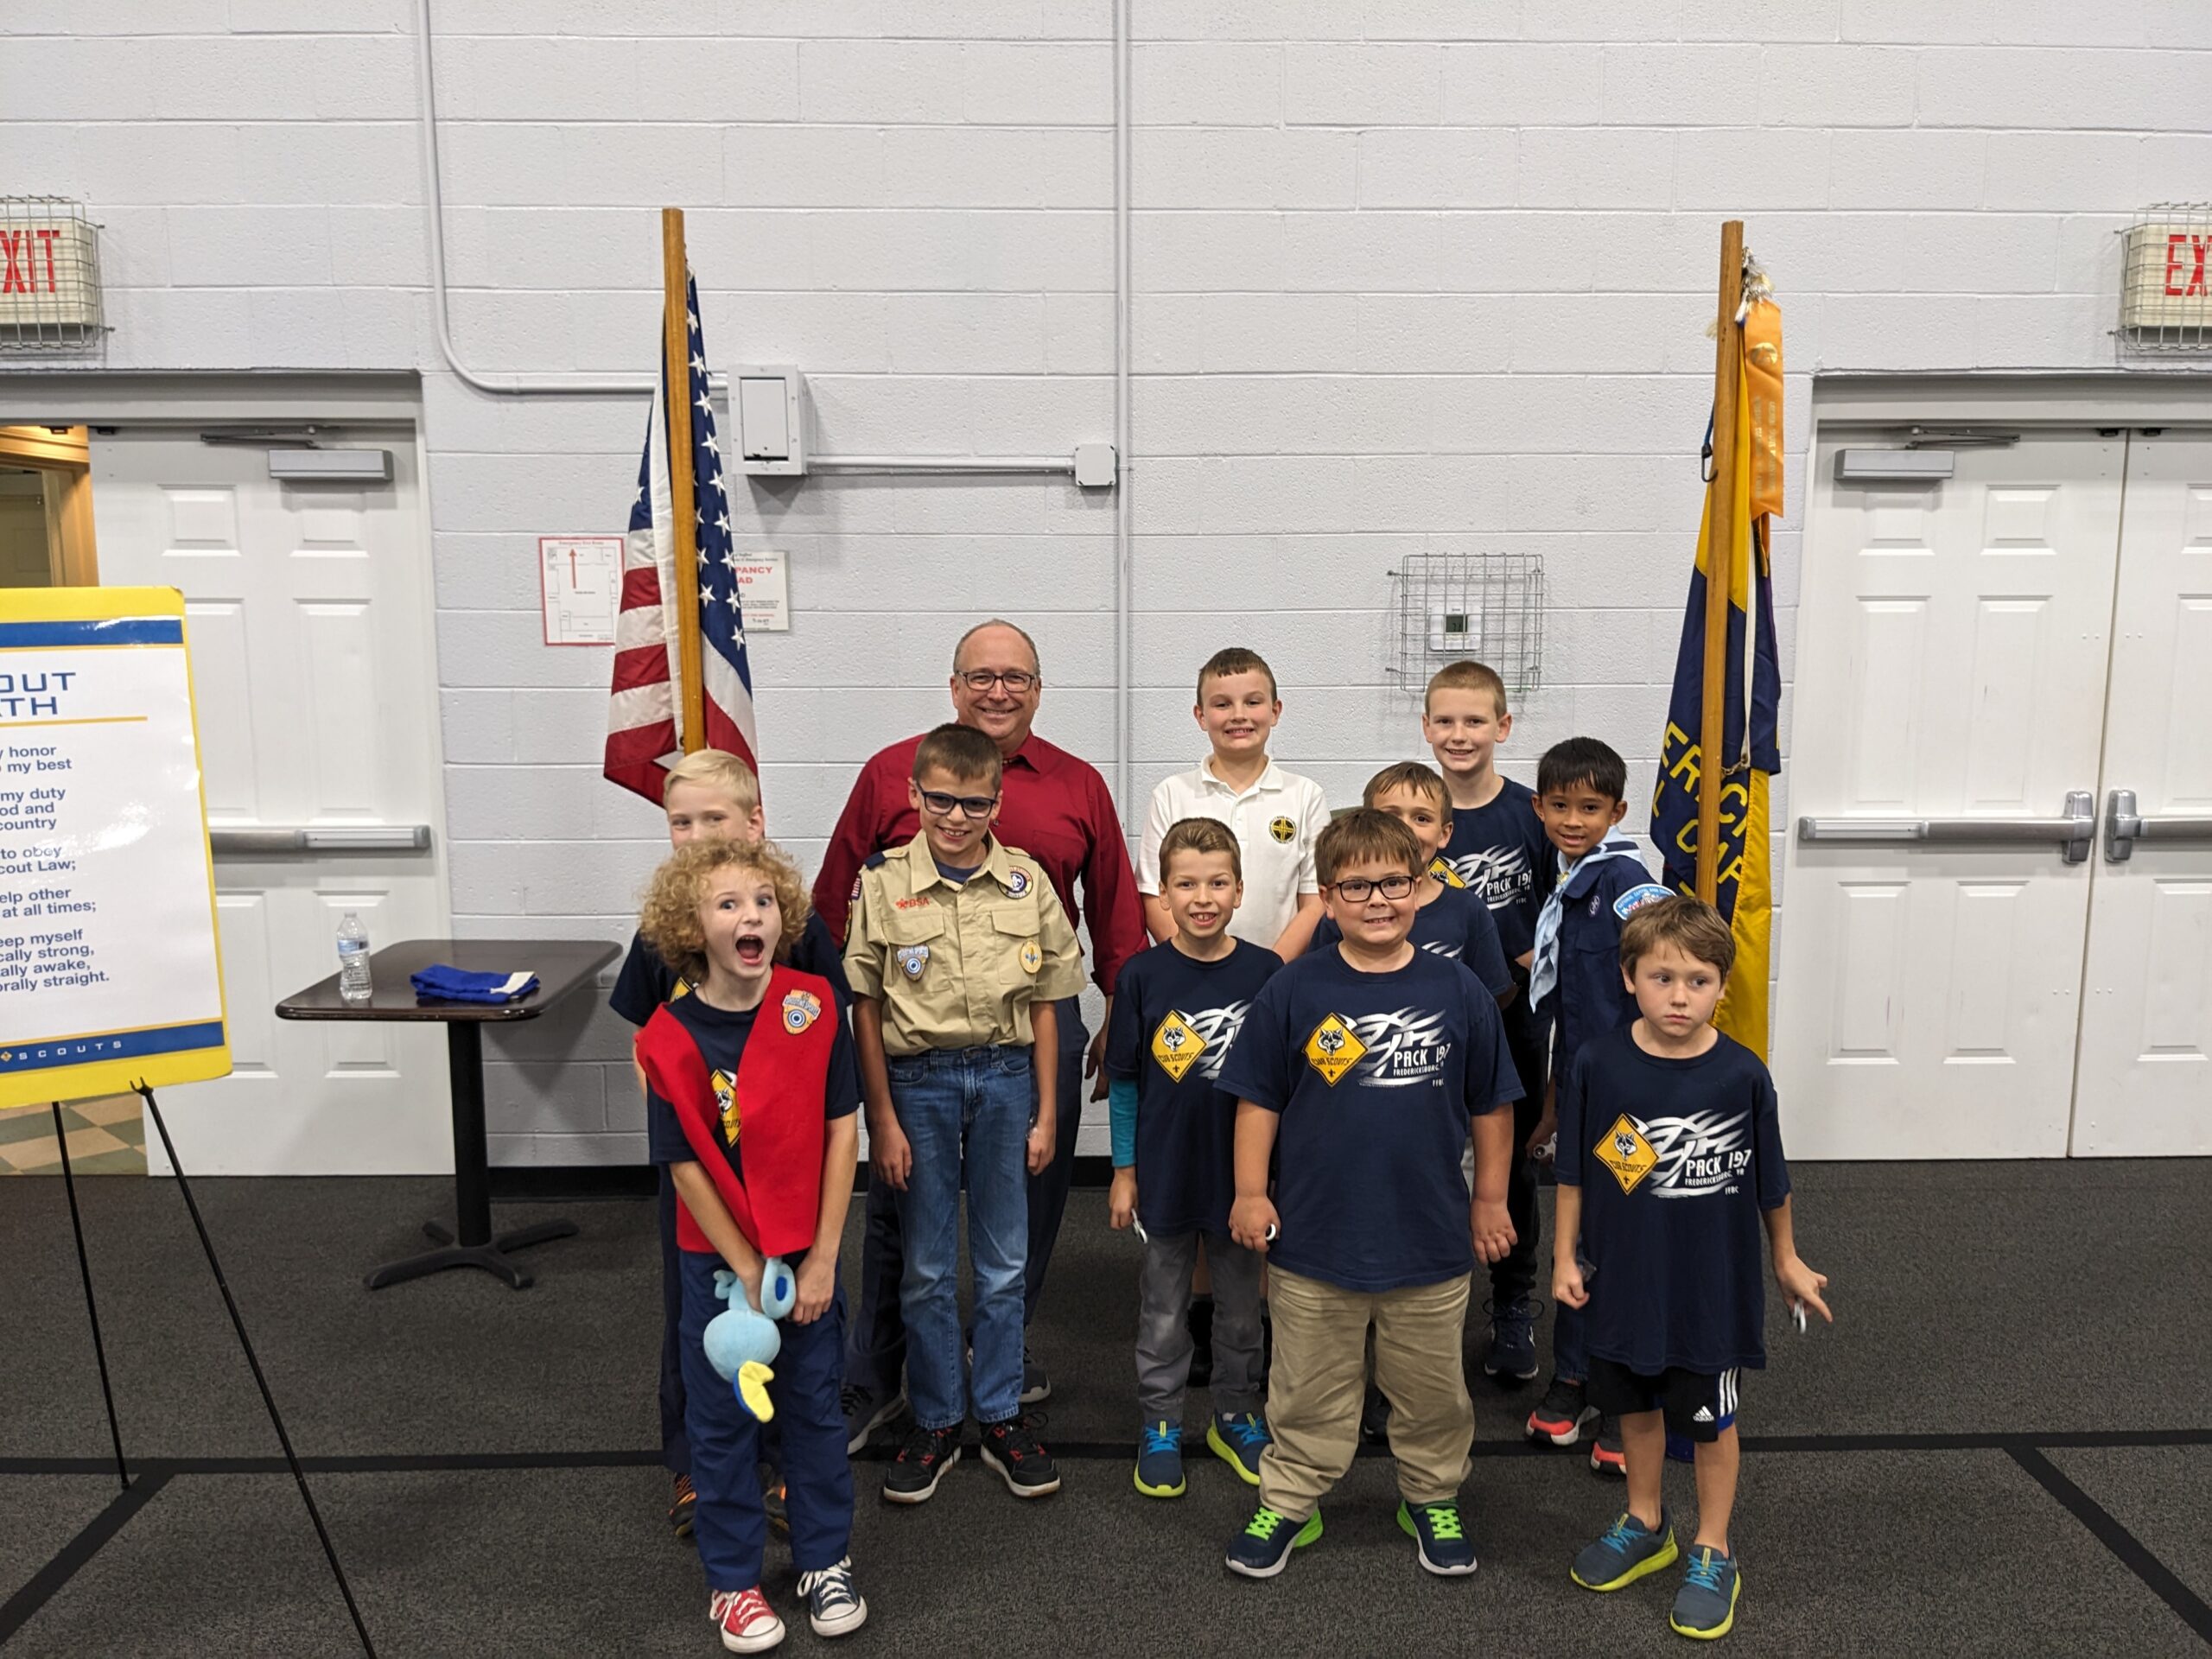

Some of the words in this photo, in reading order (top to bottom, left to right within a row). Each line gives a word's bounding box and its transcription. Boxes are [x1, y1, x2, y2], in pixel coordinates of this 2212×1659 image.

[0, 696, 58, 717] TH
[9, 746, 57, 758] honor
[7, 762, 31, 774] my
[36, 758, 73, 771] best
[0, 791, 24, 803] my
[29, 787, 66, 801] duty
[24, 801, 54, 815] and
[1, 848, 17, 860] to
[38, 860, 77, 872] Law;
[1486, 876, 1511, 896] PACK
[28, 888, 72, 901] other
[909, 897, 930, 908] BSA
[2, 906, 18, 918] at
[23, 903, 41, 917] all
[47, 899, 97, 914] times;
[30, 929, 84, 946] myself
[37, 944, 95, 960] strong,
[33, 959, 92, 975] awake,
[43, 970, 111, 988] straight.
[1394, 1048, 1428, 1068] PACK
[1436, 1042, 1452, 1063] 197
[1686, 1154, 1721, 1177] PACK
[1728, 1148, 1752, 1169] 197
